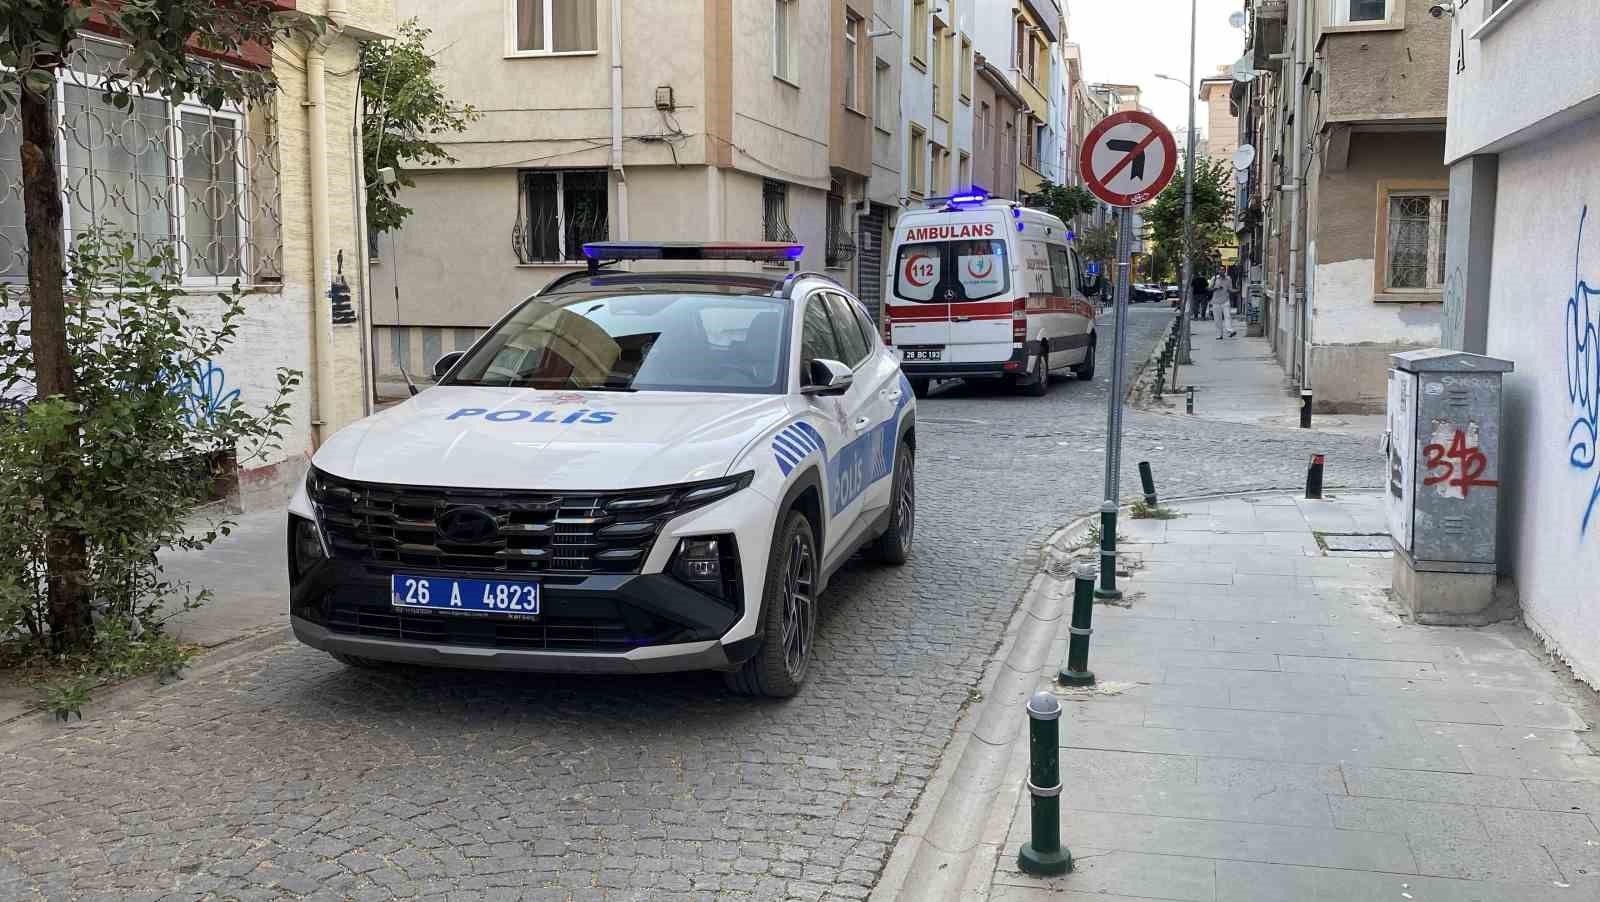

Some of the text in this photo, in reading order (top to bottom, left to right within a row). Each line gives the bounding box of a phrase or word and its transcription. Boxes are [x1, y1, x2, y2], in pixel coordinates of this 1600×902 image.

[906, 224, 994, 242] AMBULANS
[912, 263, 933, 277] 112
[917, 351, 927, 359] BC
[446, 408, 617, 424] POLİS
[405, 579, 536, 610] 26 A 4823
